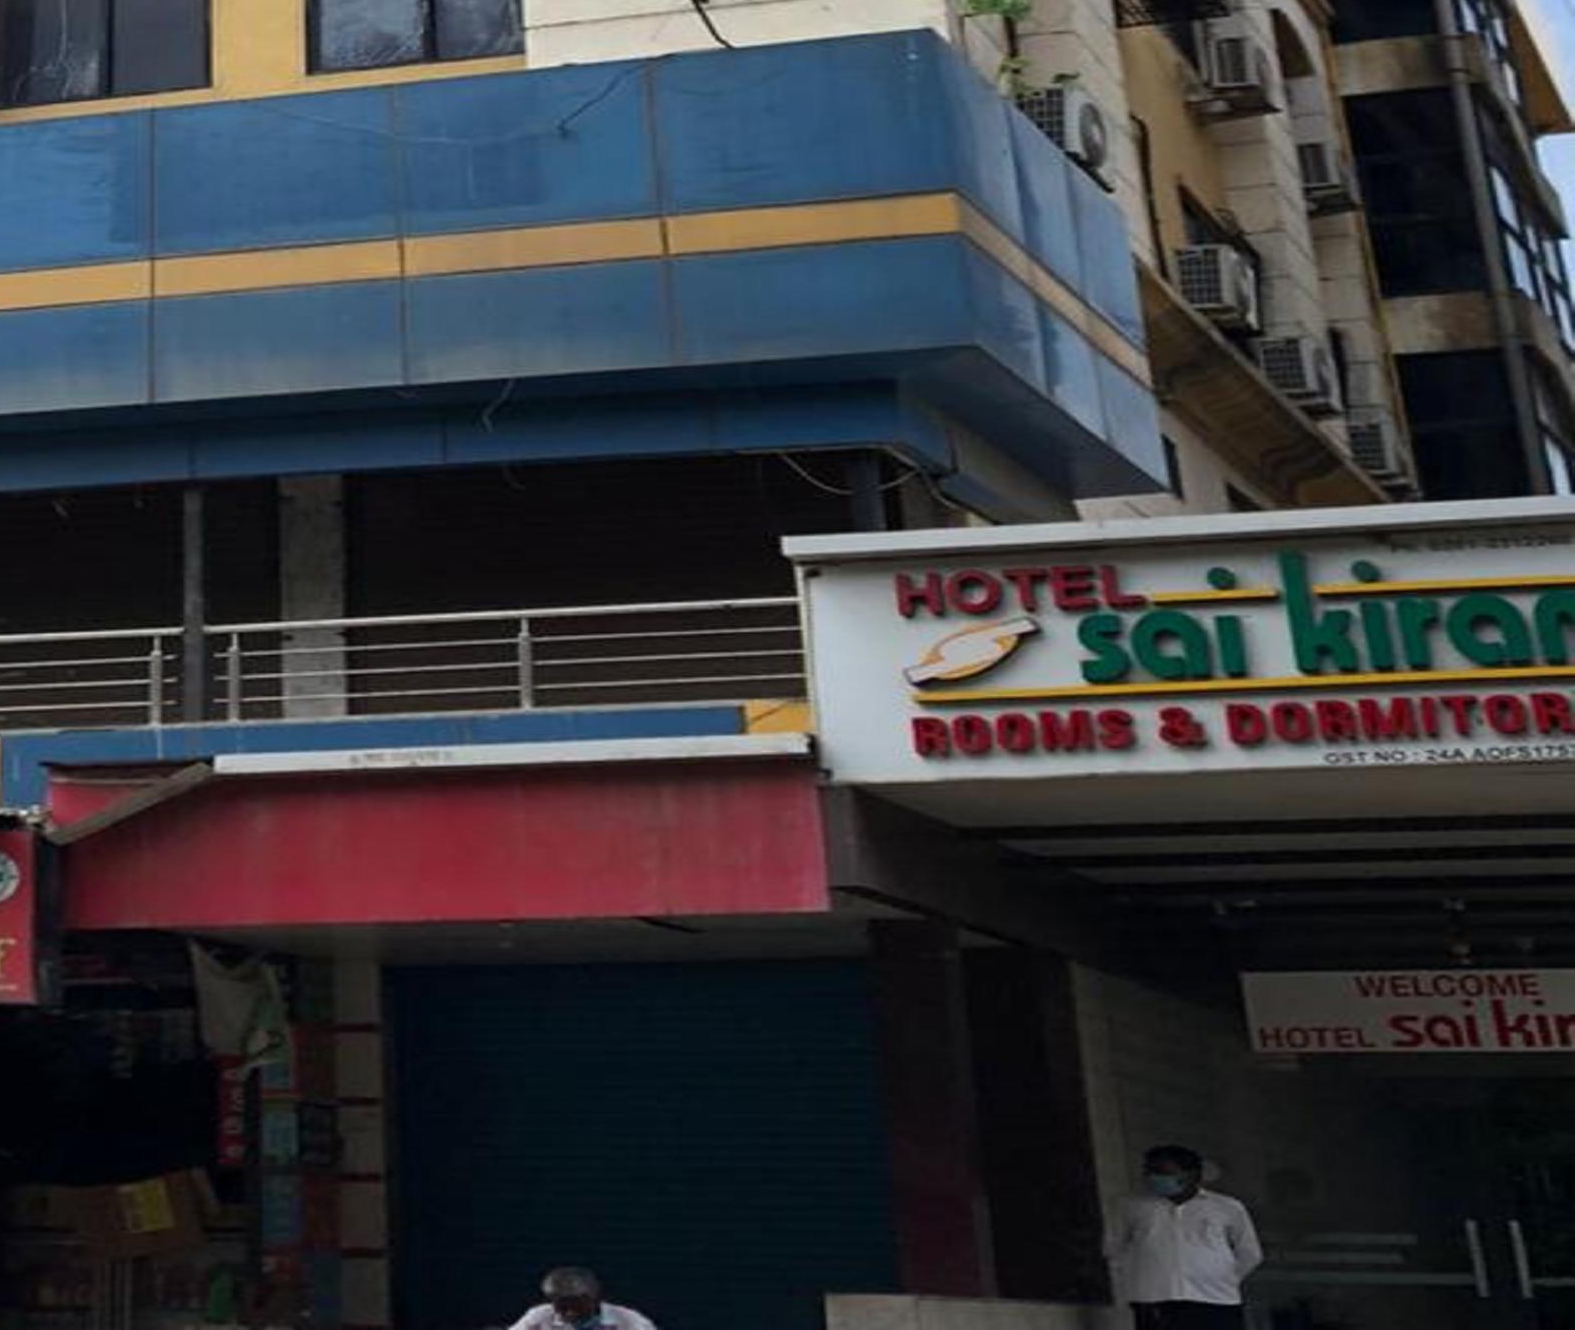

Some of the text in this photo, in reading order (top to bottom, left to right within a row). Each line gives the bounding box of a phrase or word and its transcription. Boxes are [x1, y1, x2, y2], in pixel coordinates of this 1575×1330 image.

[893, 563, 1149, 620] HOTEL
[1078, 566, 1248, 685] sai
[910, 707, 1135, 759] ROOMS
[1158, 705, 1208, 748] &
[1324, 751, 1368, 764] GST
[1355, 974, 1541, 997] WELCOME
[1257, 1027, 1377, 1049] HOTEL
[1387, 999, 1481, 1048] sai
